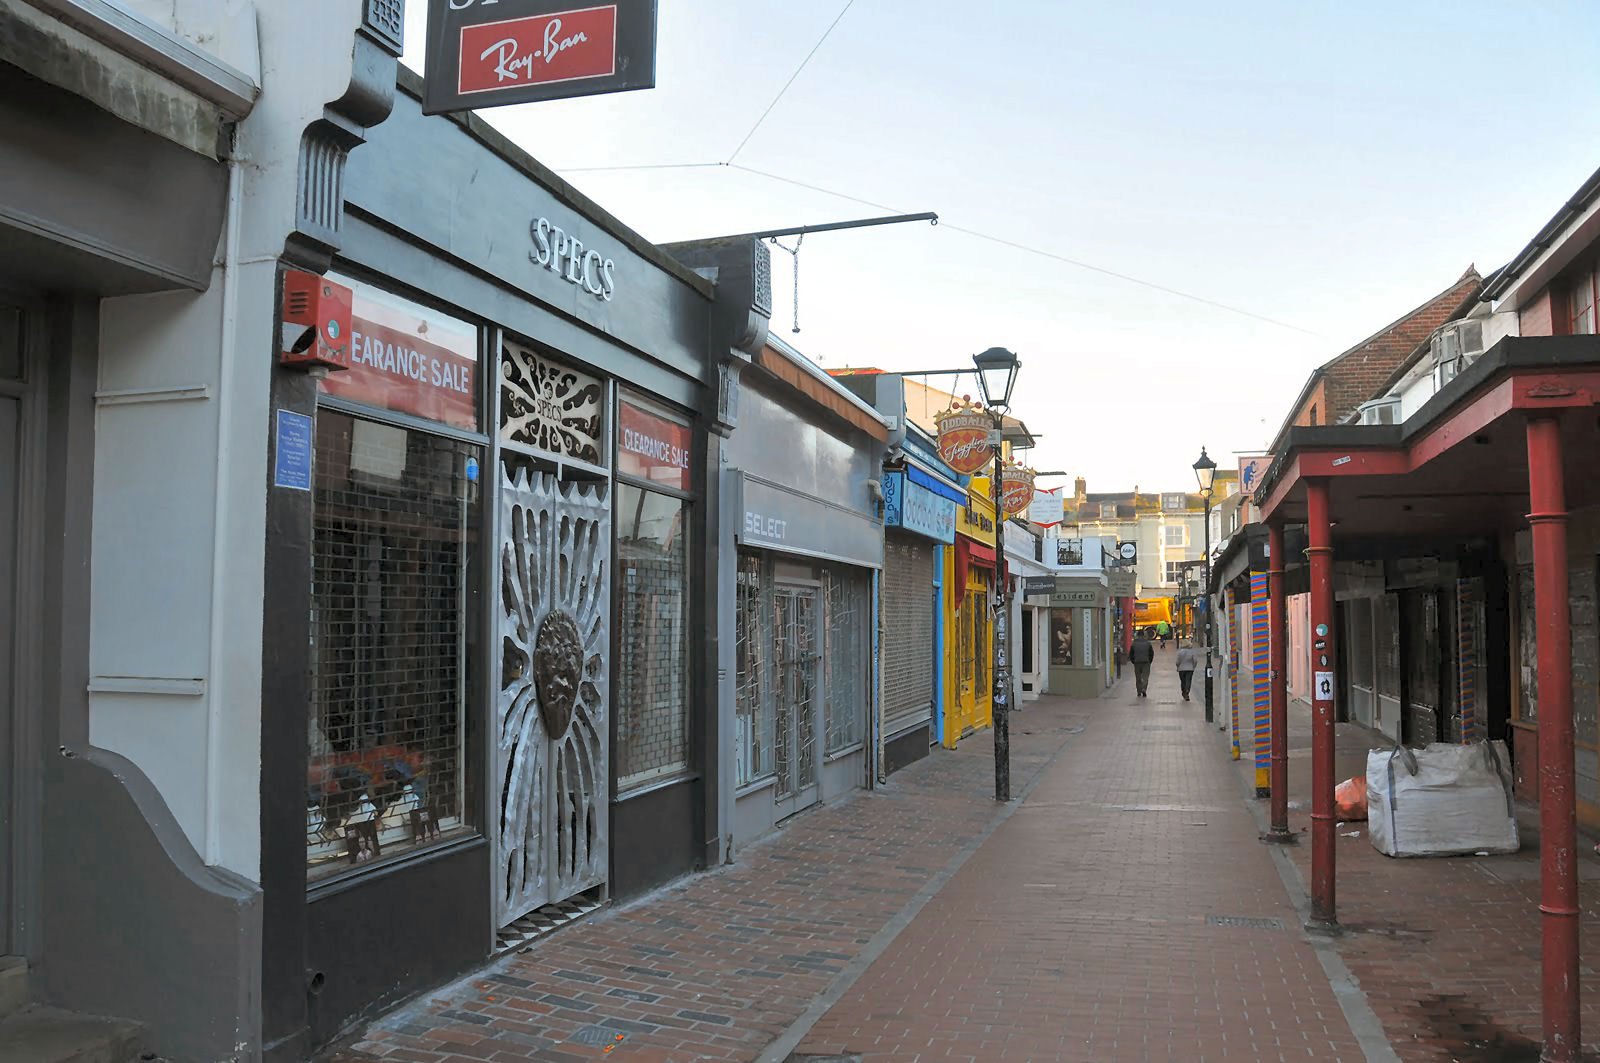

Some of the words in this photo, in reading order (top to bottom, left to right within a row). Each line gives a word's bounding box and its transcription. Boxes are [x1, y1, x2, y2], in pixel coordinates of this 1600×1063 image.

[534, 216, 615, 301] SPECS
[351, 331, 427, 383] EARANCE
[431, 358, 469, 394] SALE
[536, 398, 562, 423] SPECS
[941, 416, 993, 431] ODDBALLS
[624, 428, 670, 463] CLEARANCE
[671, 446, 689, 469] SALE
[944, 436, 988, 462] Juggling
[745, 511, 787, 539] SELECT
